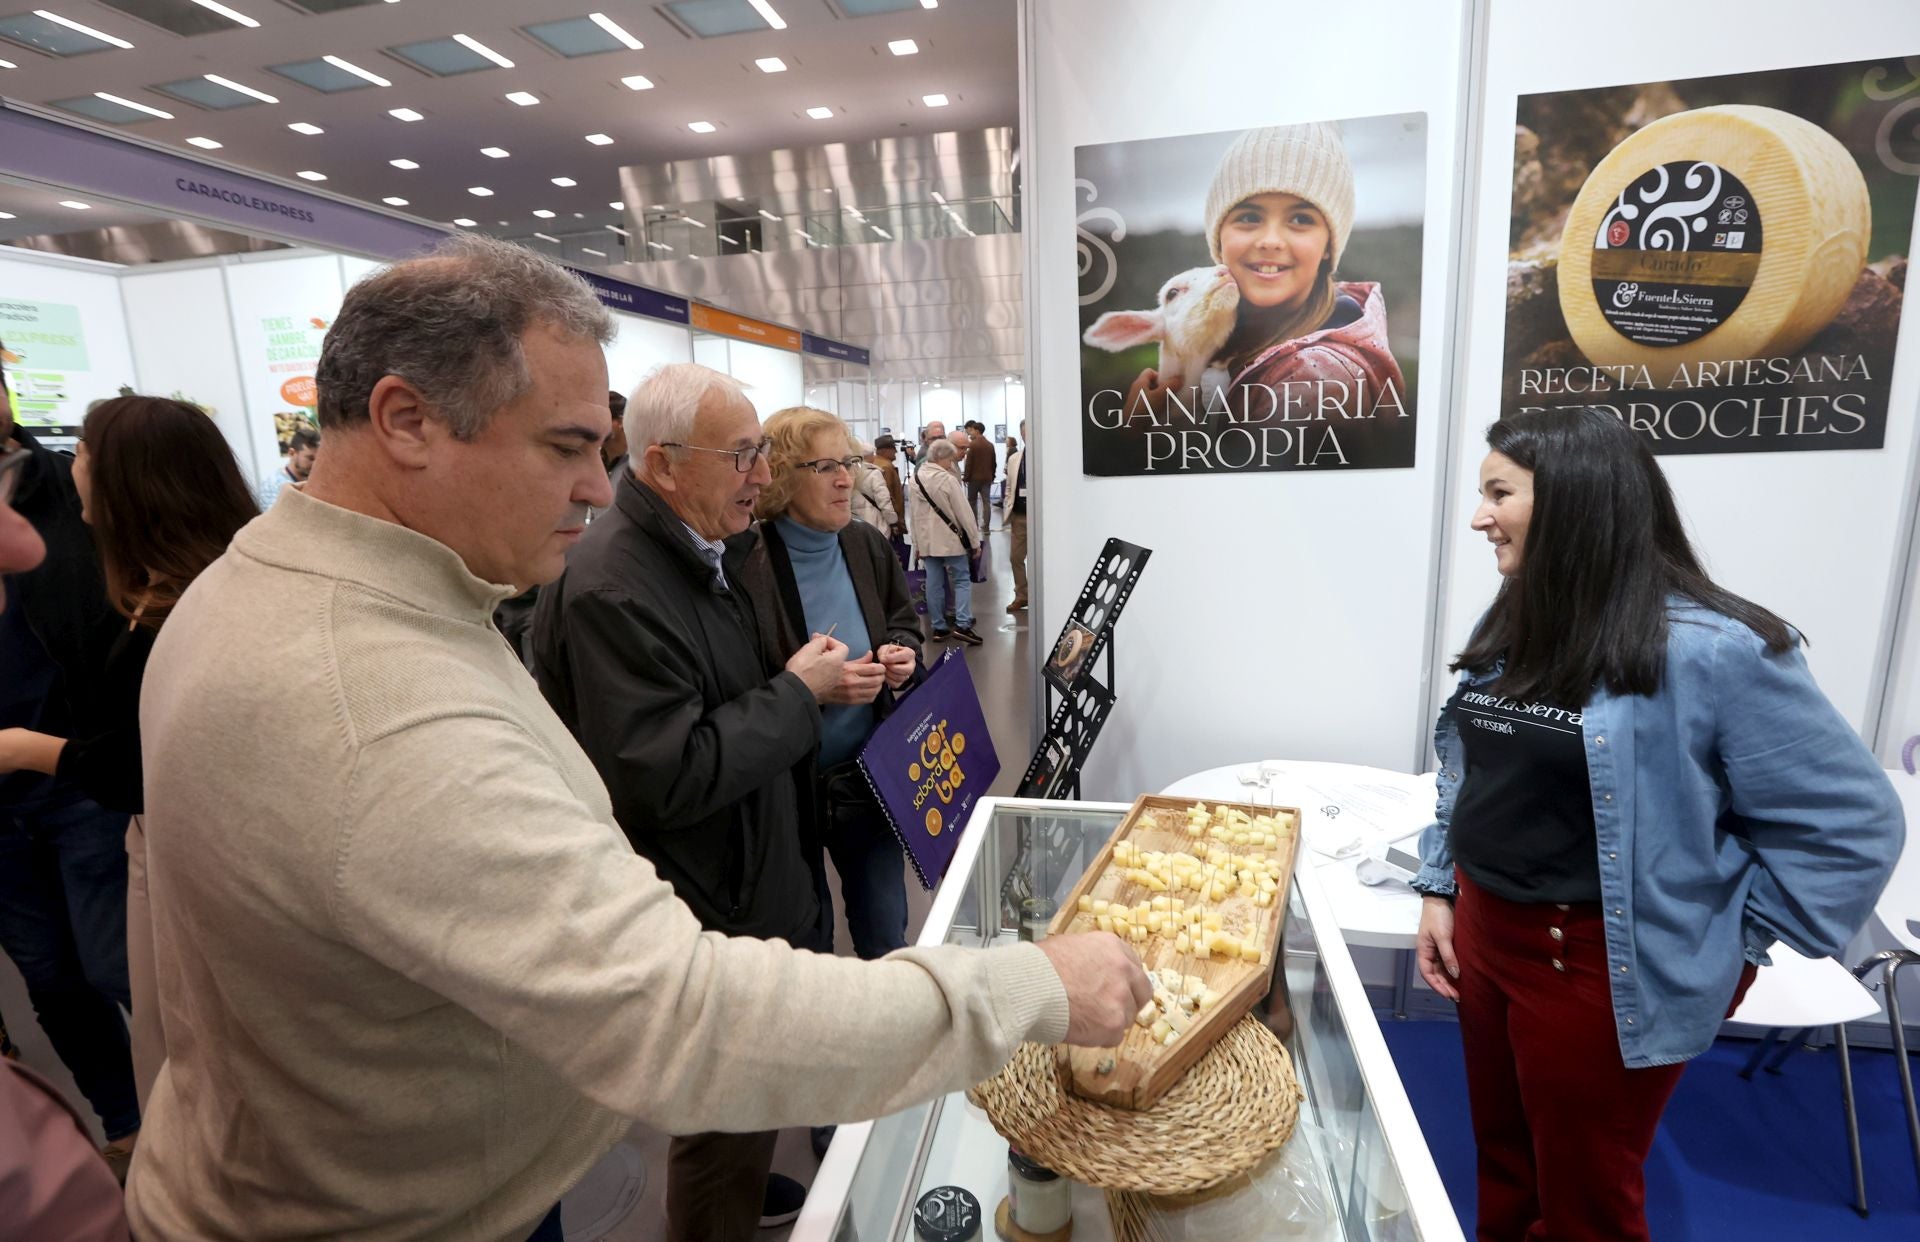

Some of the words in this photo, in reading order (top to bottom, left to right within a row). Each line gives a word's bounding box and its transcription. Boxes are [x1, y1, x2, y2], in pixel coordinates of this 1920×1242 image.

[176, 178, 315, 223] CARACOLEXPRESS
[1640, 253, 1702, 273] Curado
[1520, 364, 1656, 395] RECETA
[1667, 354, 1872, 389] ARTESANA
[1089, 375, 1410, 430] GANADERÍA
[1143, 425, 1350, 471] PROPIA
